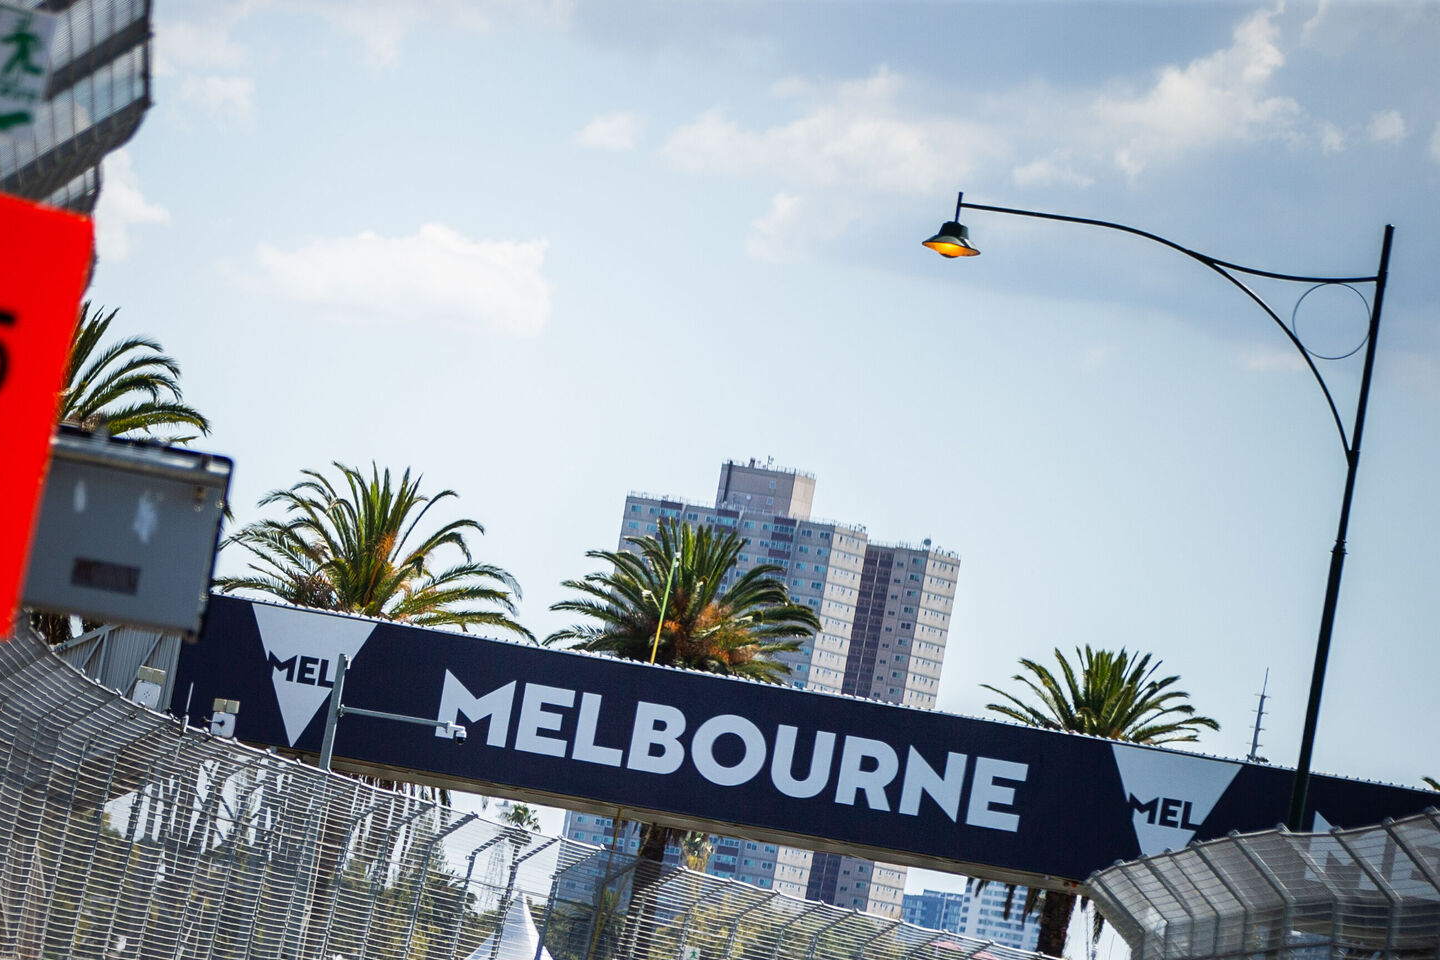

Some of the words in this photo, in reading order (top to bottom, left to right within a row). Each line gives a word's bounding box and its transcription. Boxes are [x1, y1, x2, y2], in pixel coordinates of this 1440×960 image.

[266, 650, 335, 688] MEL
[434, 668, 1028, 833] MELBOURNE
[1127, 792, 1201, 831] MEL
